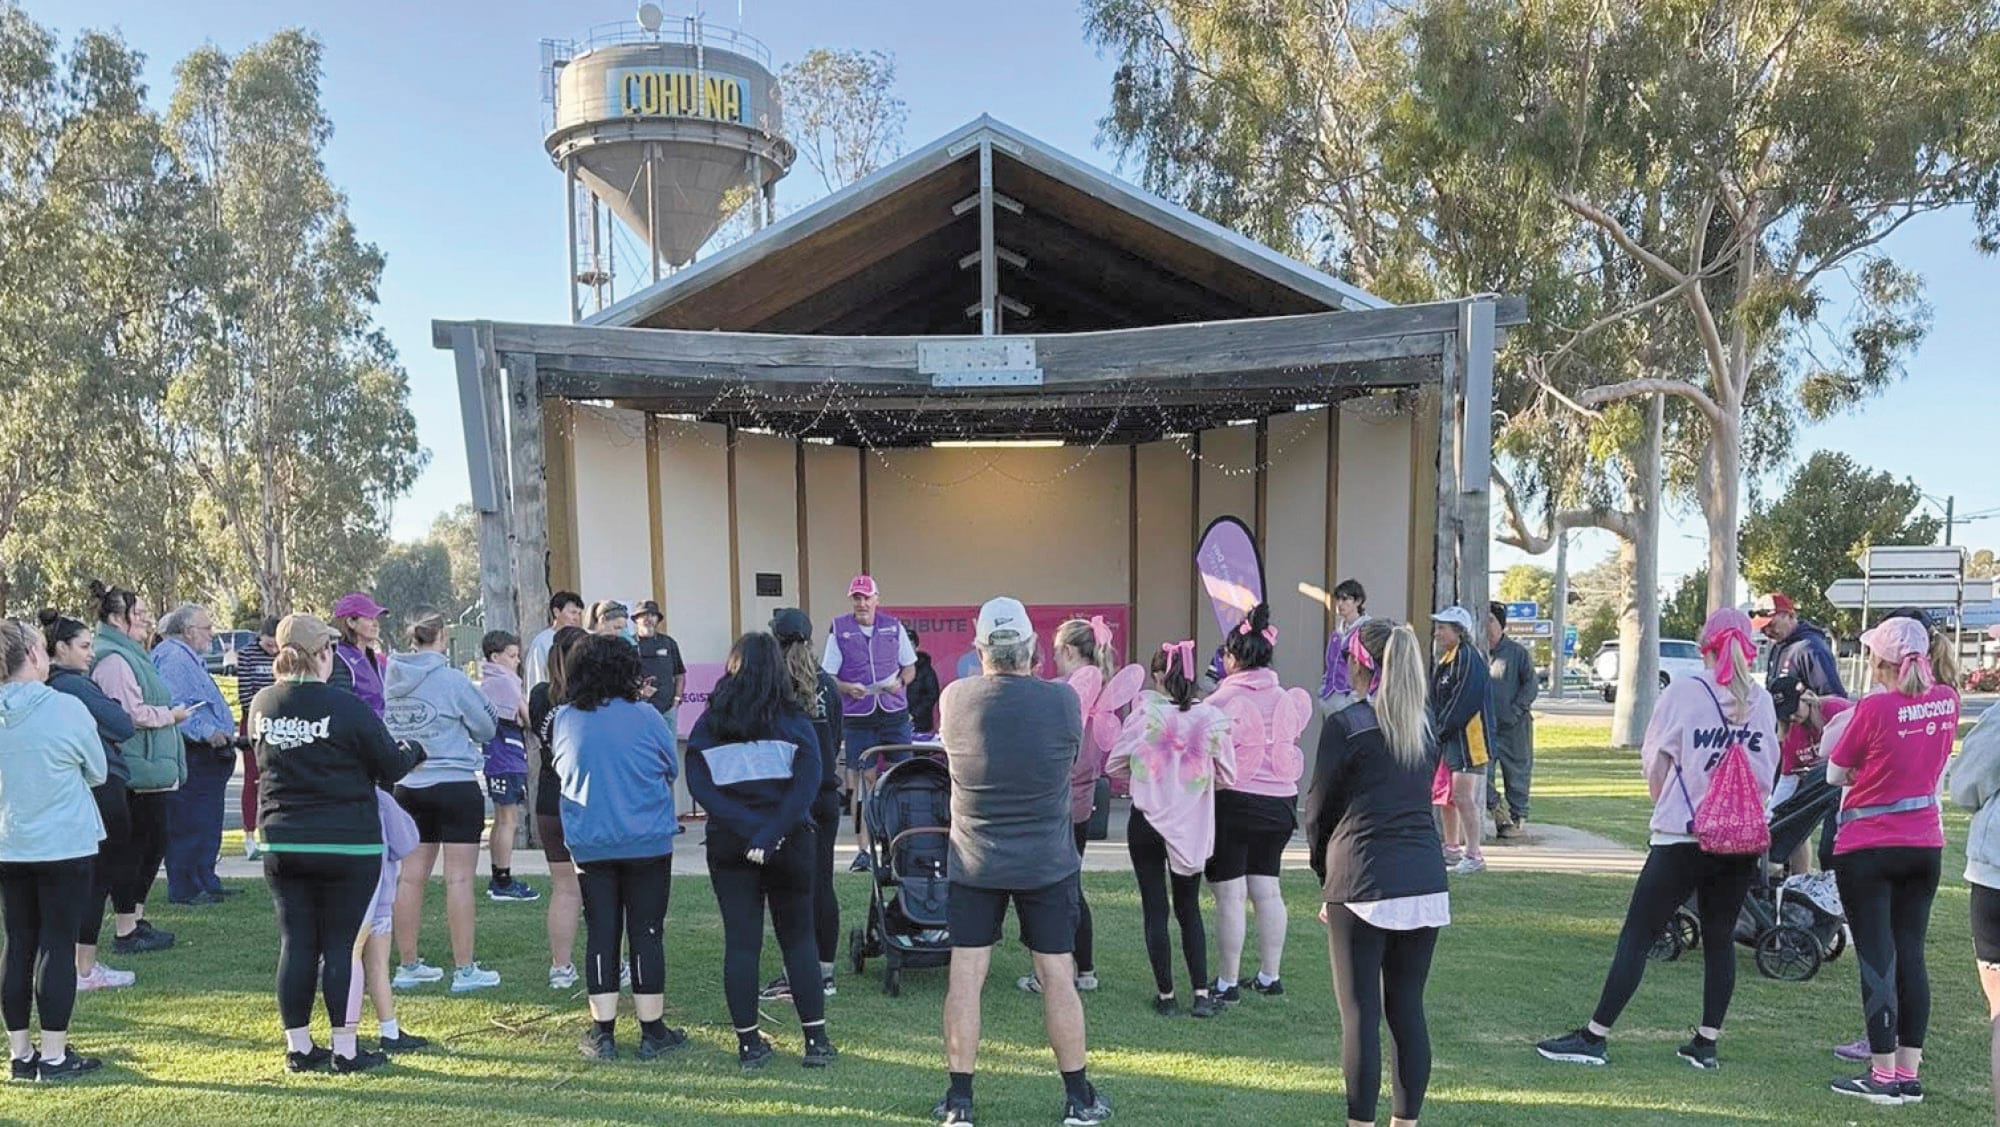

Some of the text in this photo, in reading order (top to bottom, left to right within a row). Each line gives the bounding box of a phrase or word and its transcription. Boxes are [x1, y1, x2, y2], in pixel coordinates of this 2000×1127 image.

[620, 71, 742, 122] COHUNA
[900, 619, 968, 633] RIBUTE
[681, 693, 710, 703] EGIST
[1694, 727, 1763, 752] WHITE
